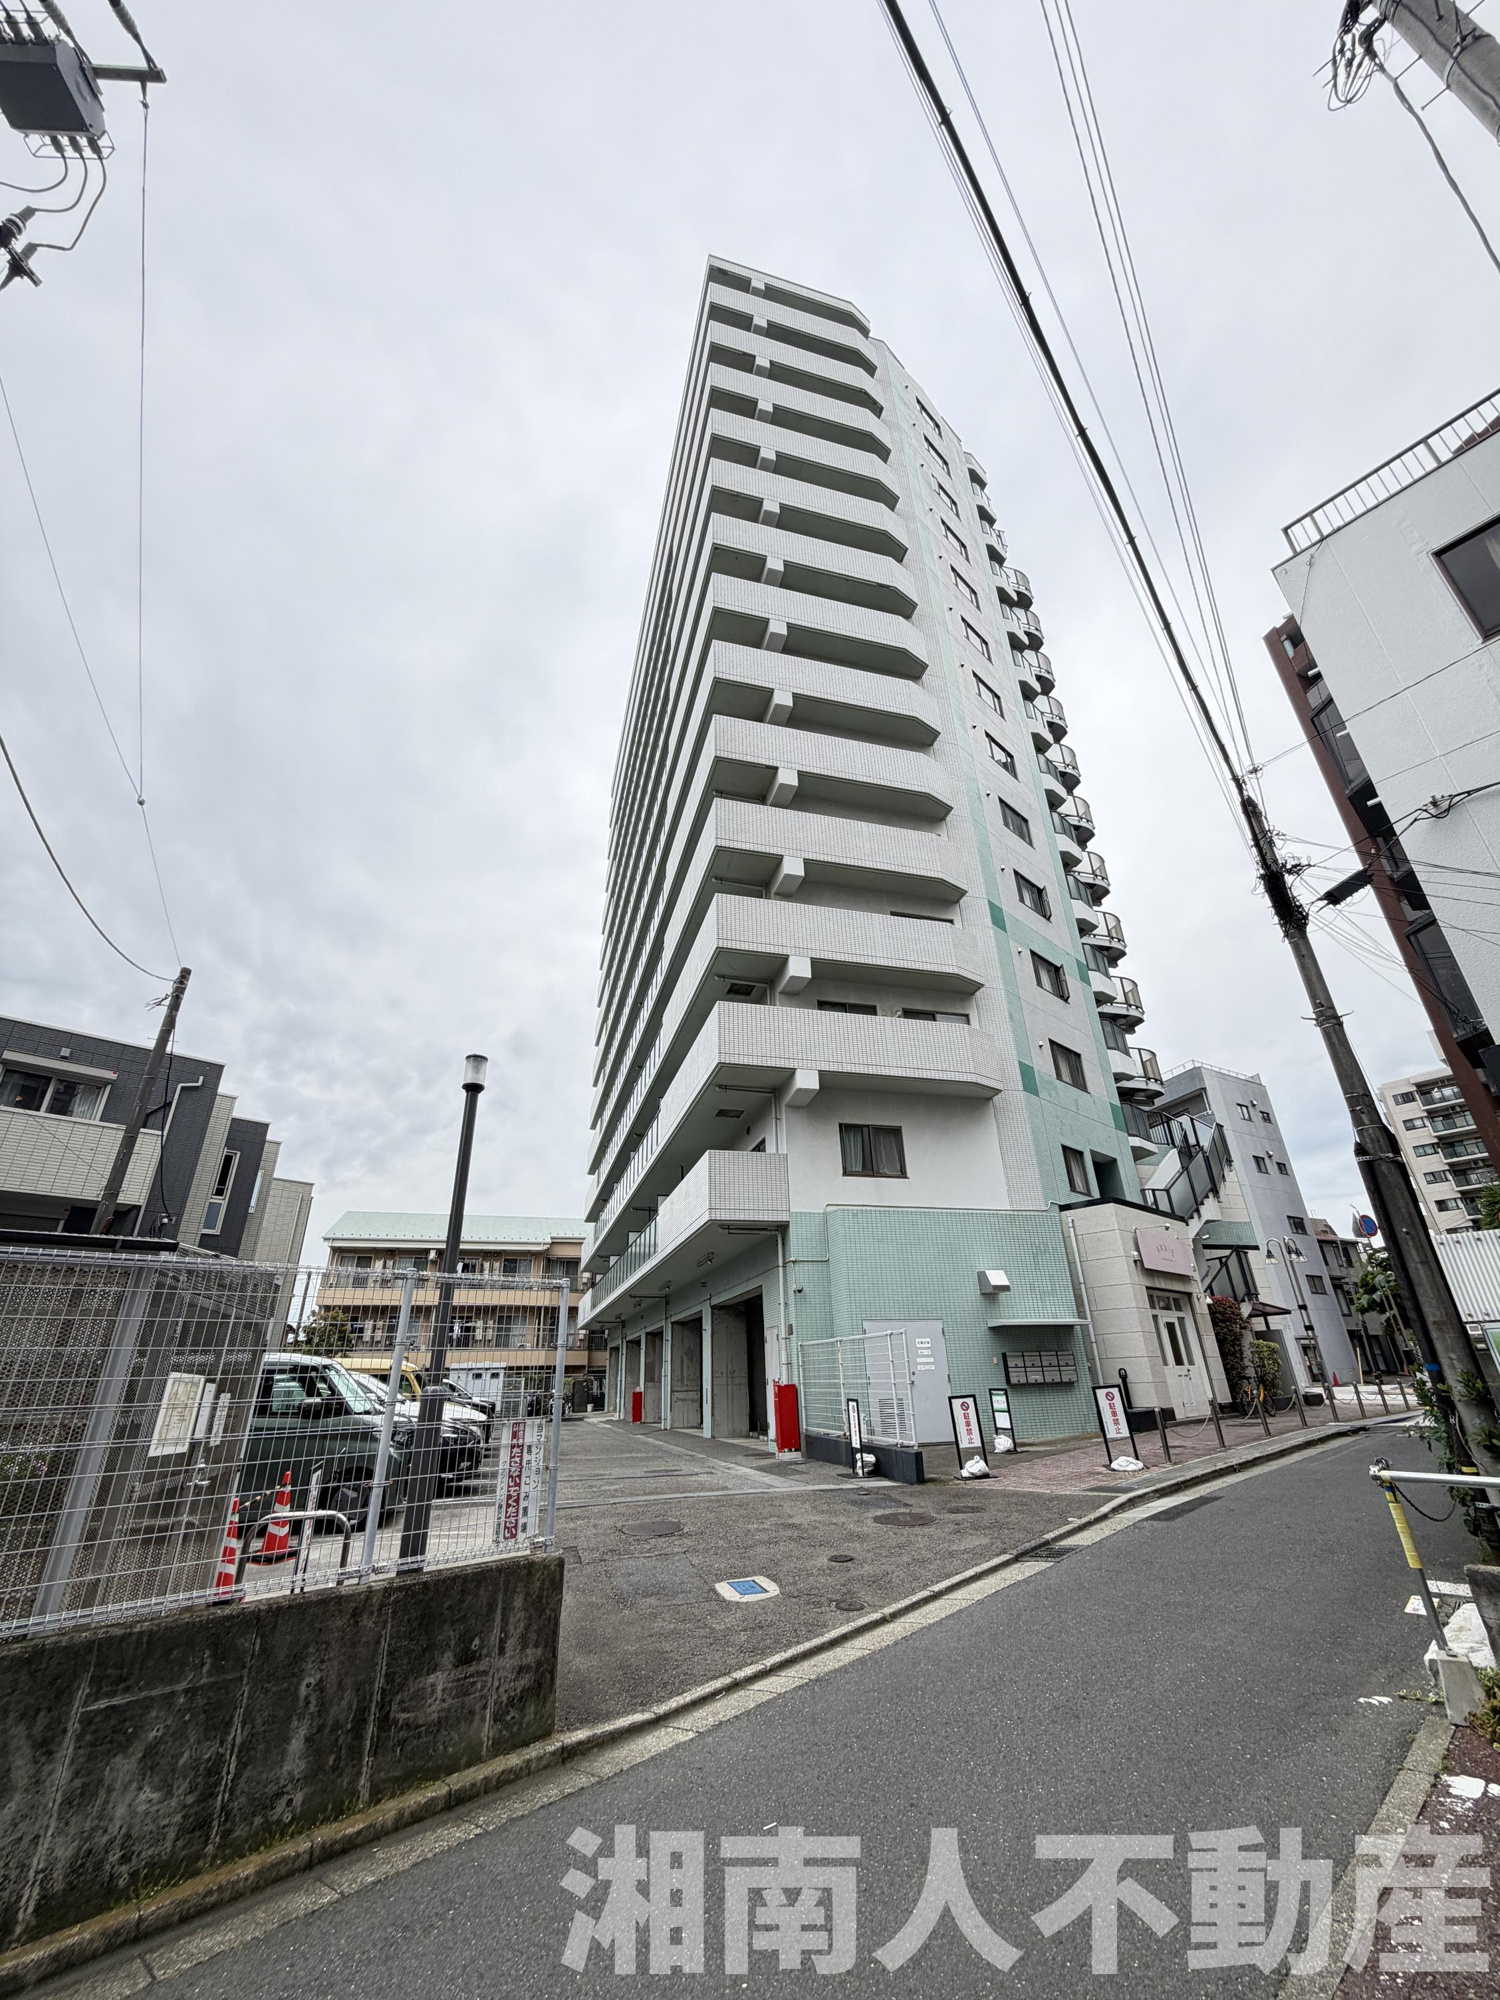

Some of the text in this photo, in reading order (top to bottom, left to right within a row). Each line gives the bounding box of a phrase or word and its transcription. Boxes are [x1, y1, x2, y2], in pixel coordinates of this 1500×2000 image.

[962, 1412, 975, 1444] 駐車禁止
[1108, 1402, 1122, 1434] 駐車禁止
[532, 1422, 543, 1489] 当マンション
